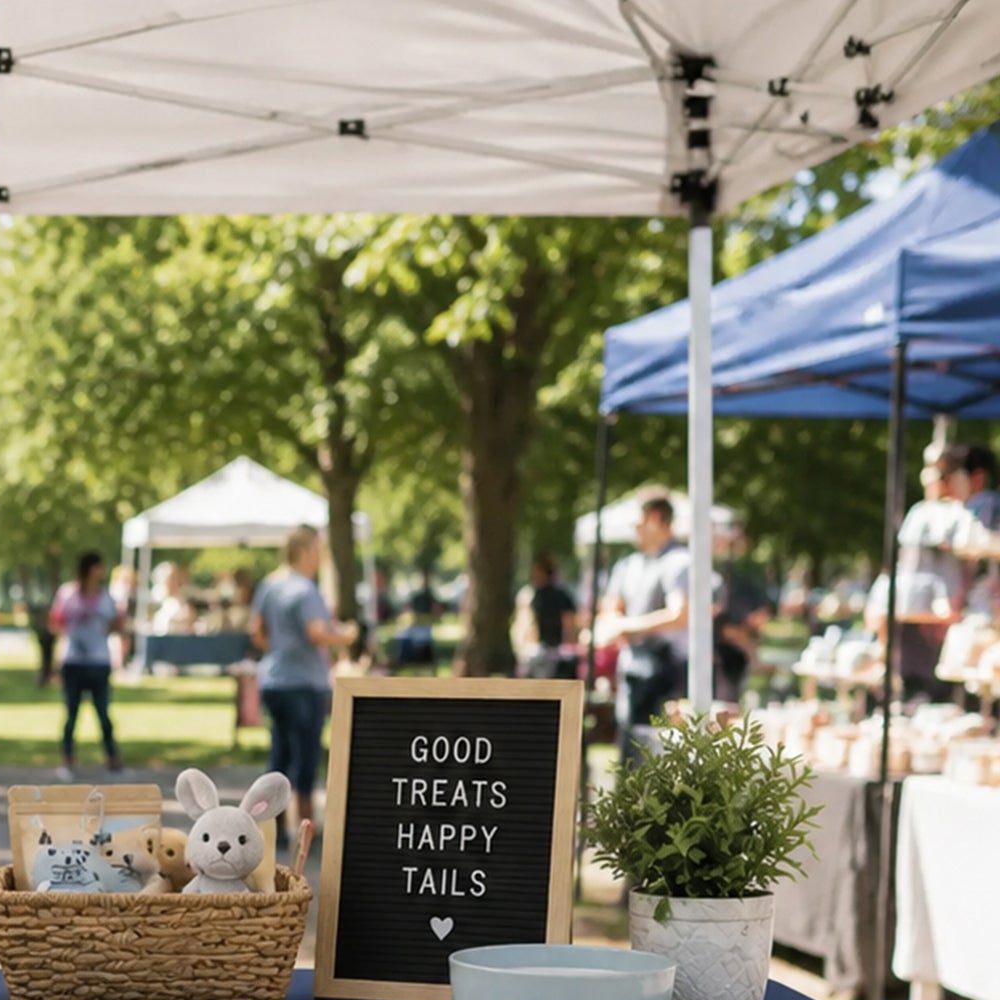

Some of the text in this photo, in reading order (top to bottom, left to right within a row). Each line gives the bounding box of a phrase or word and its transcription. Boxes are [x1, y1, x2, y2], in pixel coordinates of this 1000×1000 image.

[411, 735, 492, 764] GOOD
[391, 777, 507, 809] TREATS
[397, 823, 498, 853] HAPPY
[402, 866, 486, 897] TAILS
